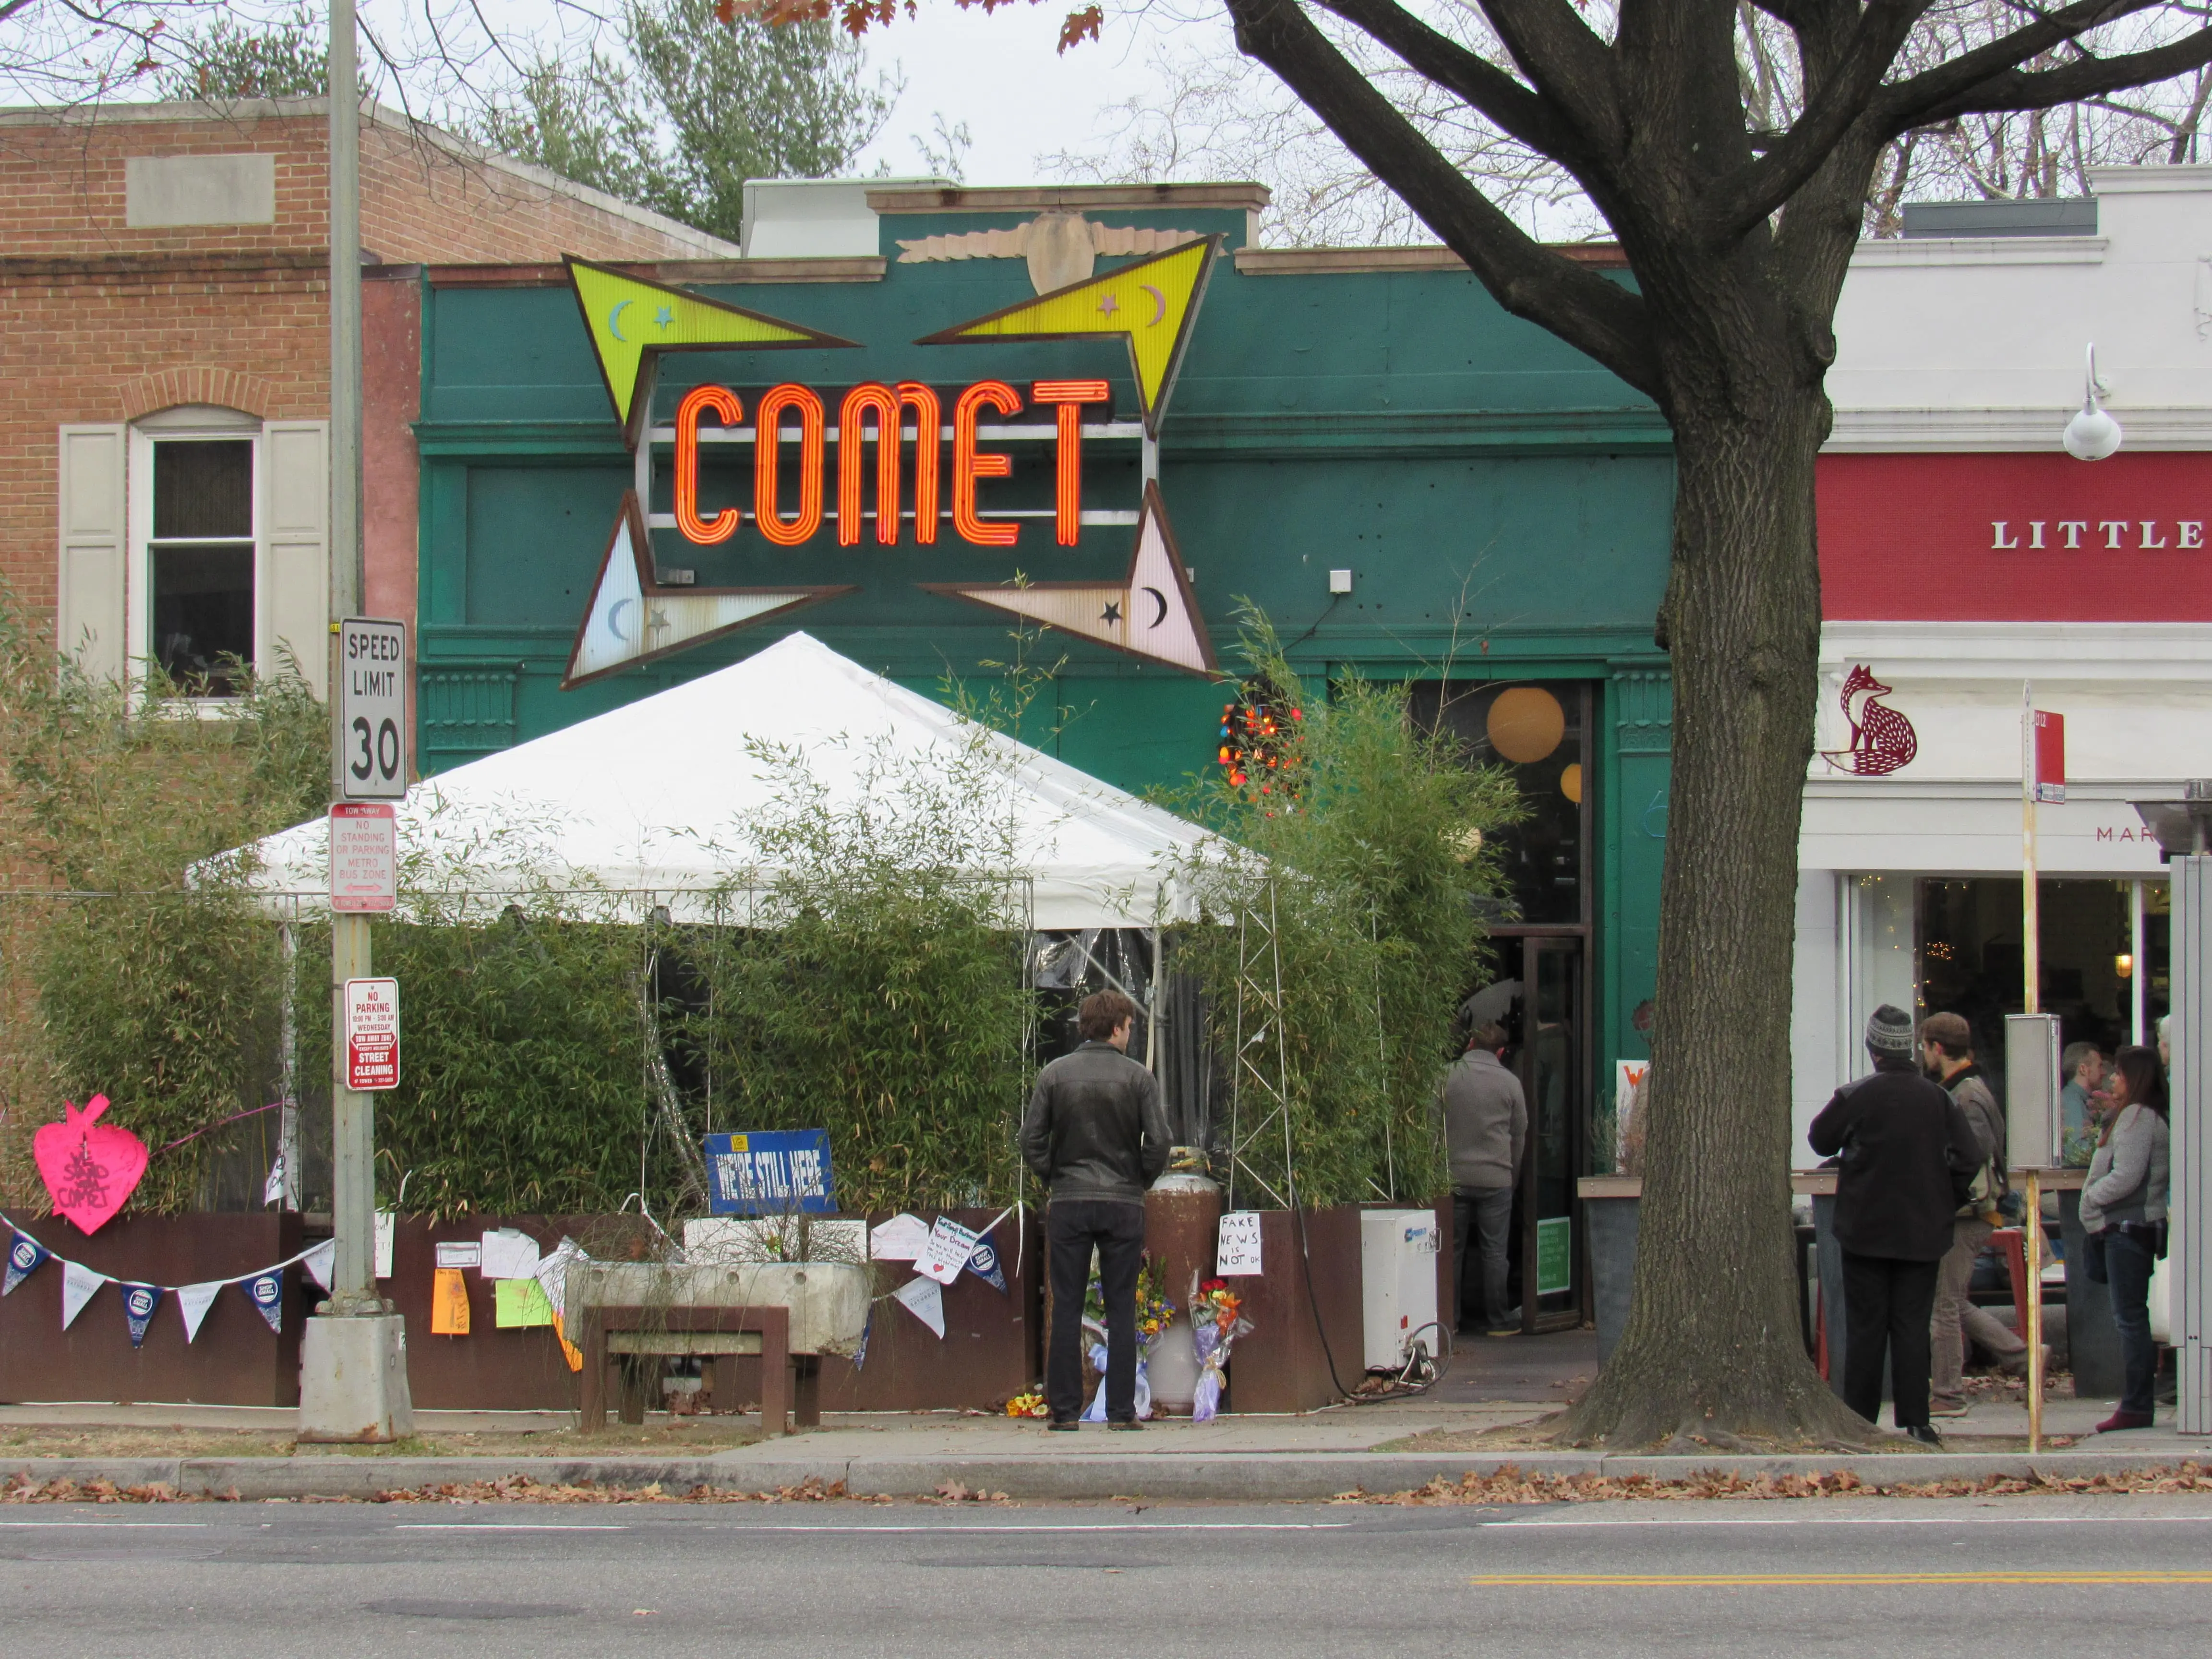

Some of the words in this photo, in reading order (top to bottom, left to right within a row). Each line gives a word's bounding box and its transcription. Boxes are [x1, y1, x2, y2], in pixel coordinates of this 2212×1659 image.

[674, 379, 1110, 547] COMET
[1991, 521, 2203, 549] LITTLE
[349, 633, 399, 661] SPEED
[354, 671, 395, 697] LIMIT
[351, 716, 400, 781] 30
[356, 820, 370, 830] NO
[341, 832, 385, 842] STANDING
[2096, 827, 2154, 842] MAR
[337, 845, 349, 854] OR
[352, 845, 390, 854] PARKING
[348, 858, 378, 867] METRO
[339, 870, 358, 879] BUS
[362, 870, 386, 879] ZONE
[367, 991, 379, 1001] NO
[356, 1002, 390, 1013] PARKING
[357, 1023, 391, 1032] WEDNESDAY
[359, 1051, 389, 1063] STREET
[354, 1064, 394, 1076] CLEANING
[1623, 1065, 1644, 1087] W
[716, 1153, 756, 1200] WE'RE
[755, 1151, 791, 1199] STILL
[789, 1149, 825, 1197] HERE
[58, 1185, 110, 1209] COMET
[1222, 1216, 1253, 1228] FAKE
[935, 1228, 948, 1240] Your
[949, 1236, 971, 1251] Dream
[1221, 1232, 1258, 1246] NEWS
[975, 1250, 988, 1261] SHOP
[1219, 1254, 1245, 1266] NOT
[910, 1288, 939, 1307] SATURDAY
